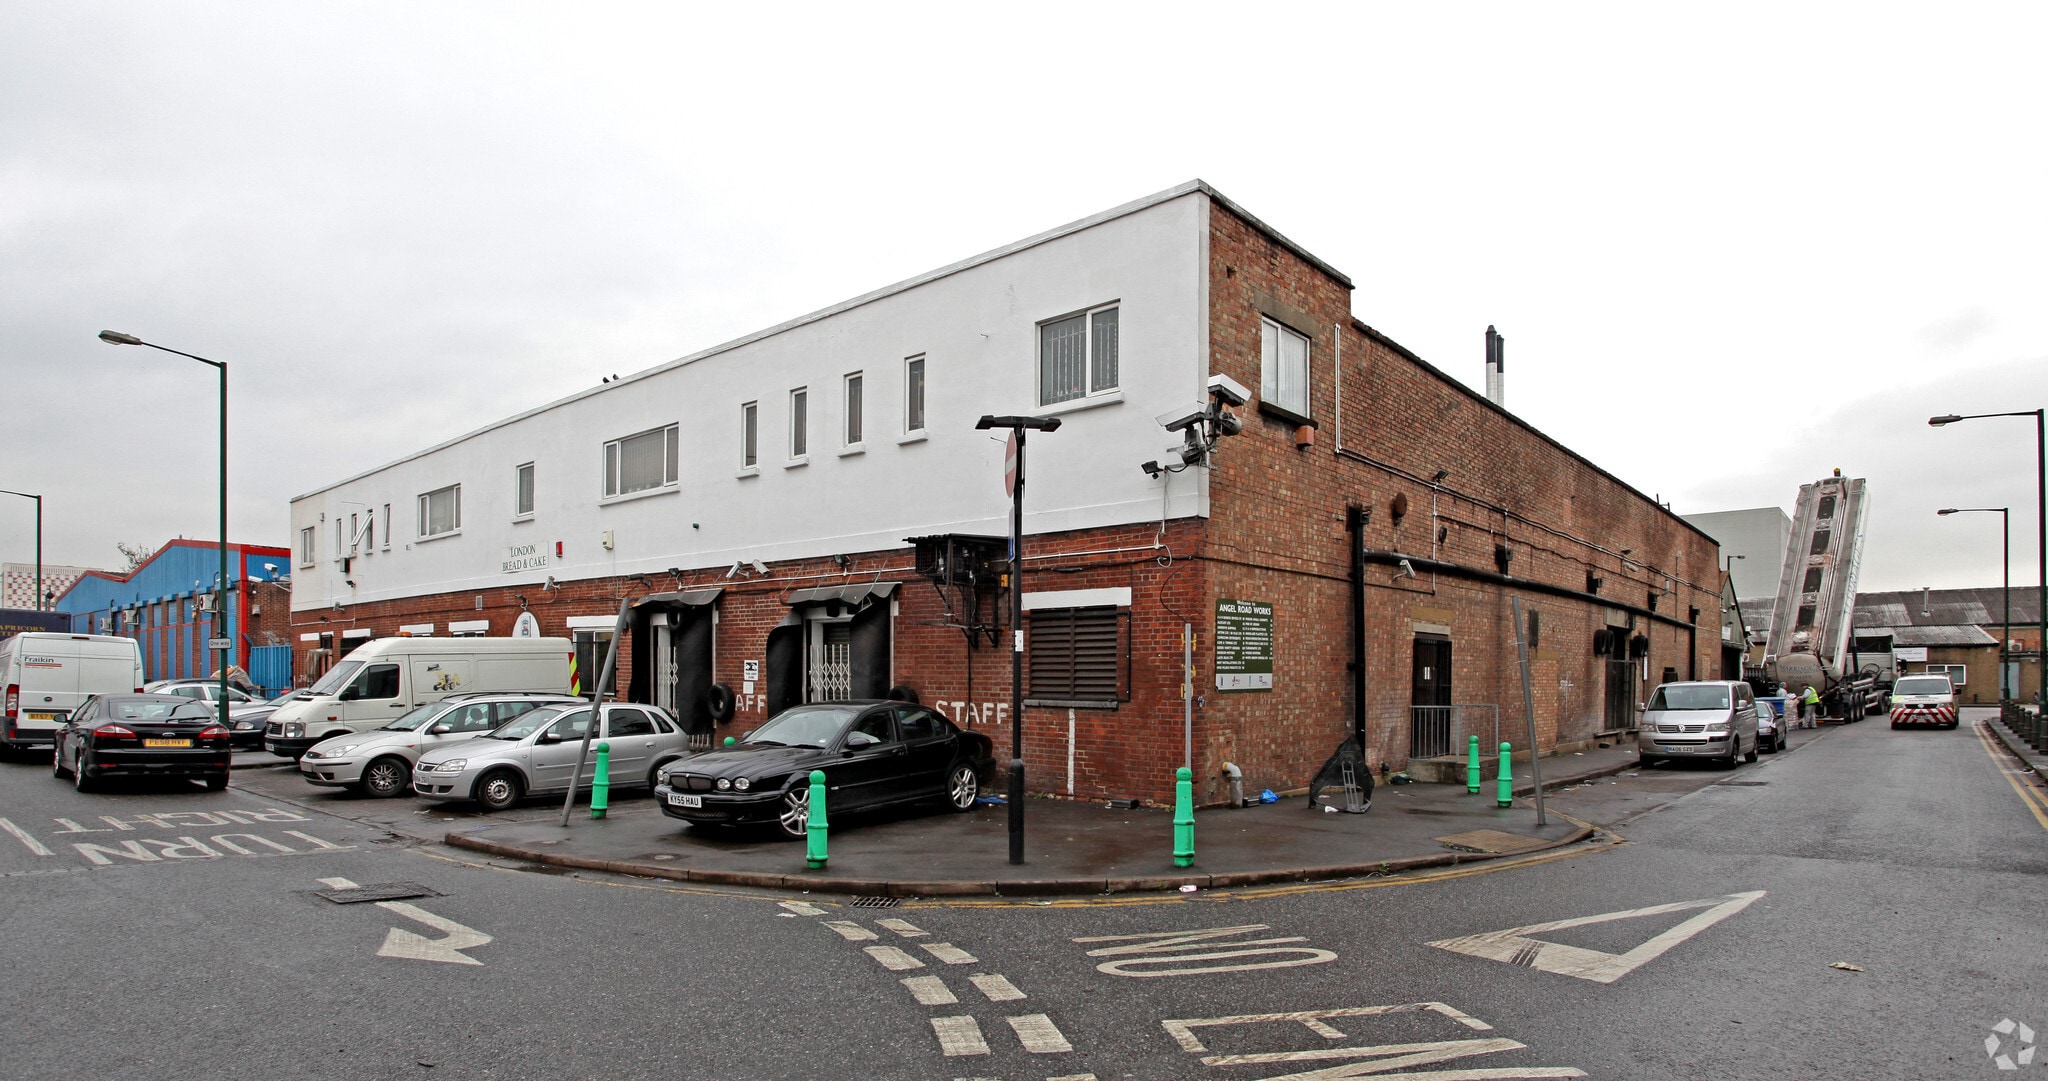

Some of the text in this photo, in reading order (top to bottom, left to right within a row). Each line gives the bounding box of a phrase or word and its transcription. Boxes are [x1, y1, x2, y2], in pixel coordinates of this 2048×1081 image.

[510, 544, 536, 558] LONDON
[502, 555, 546, 571] BREAD & CAKE
[1219, 604, 1271, 615] ANGEL ROAD WORKS
[0, 624, 46, 632] APRICORN
[735, 694, 766, 714] AFF
[935, 700, 1009, 724] STAFF
[669, 794, 699, 806] KY55 HAU
[53, 807, 313, 833] RIGHT
[72, 830, 358, 865] TURN
[1072, 924, 1338, 977] NO
